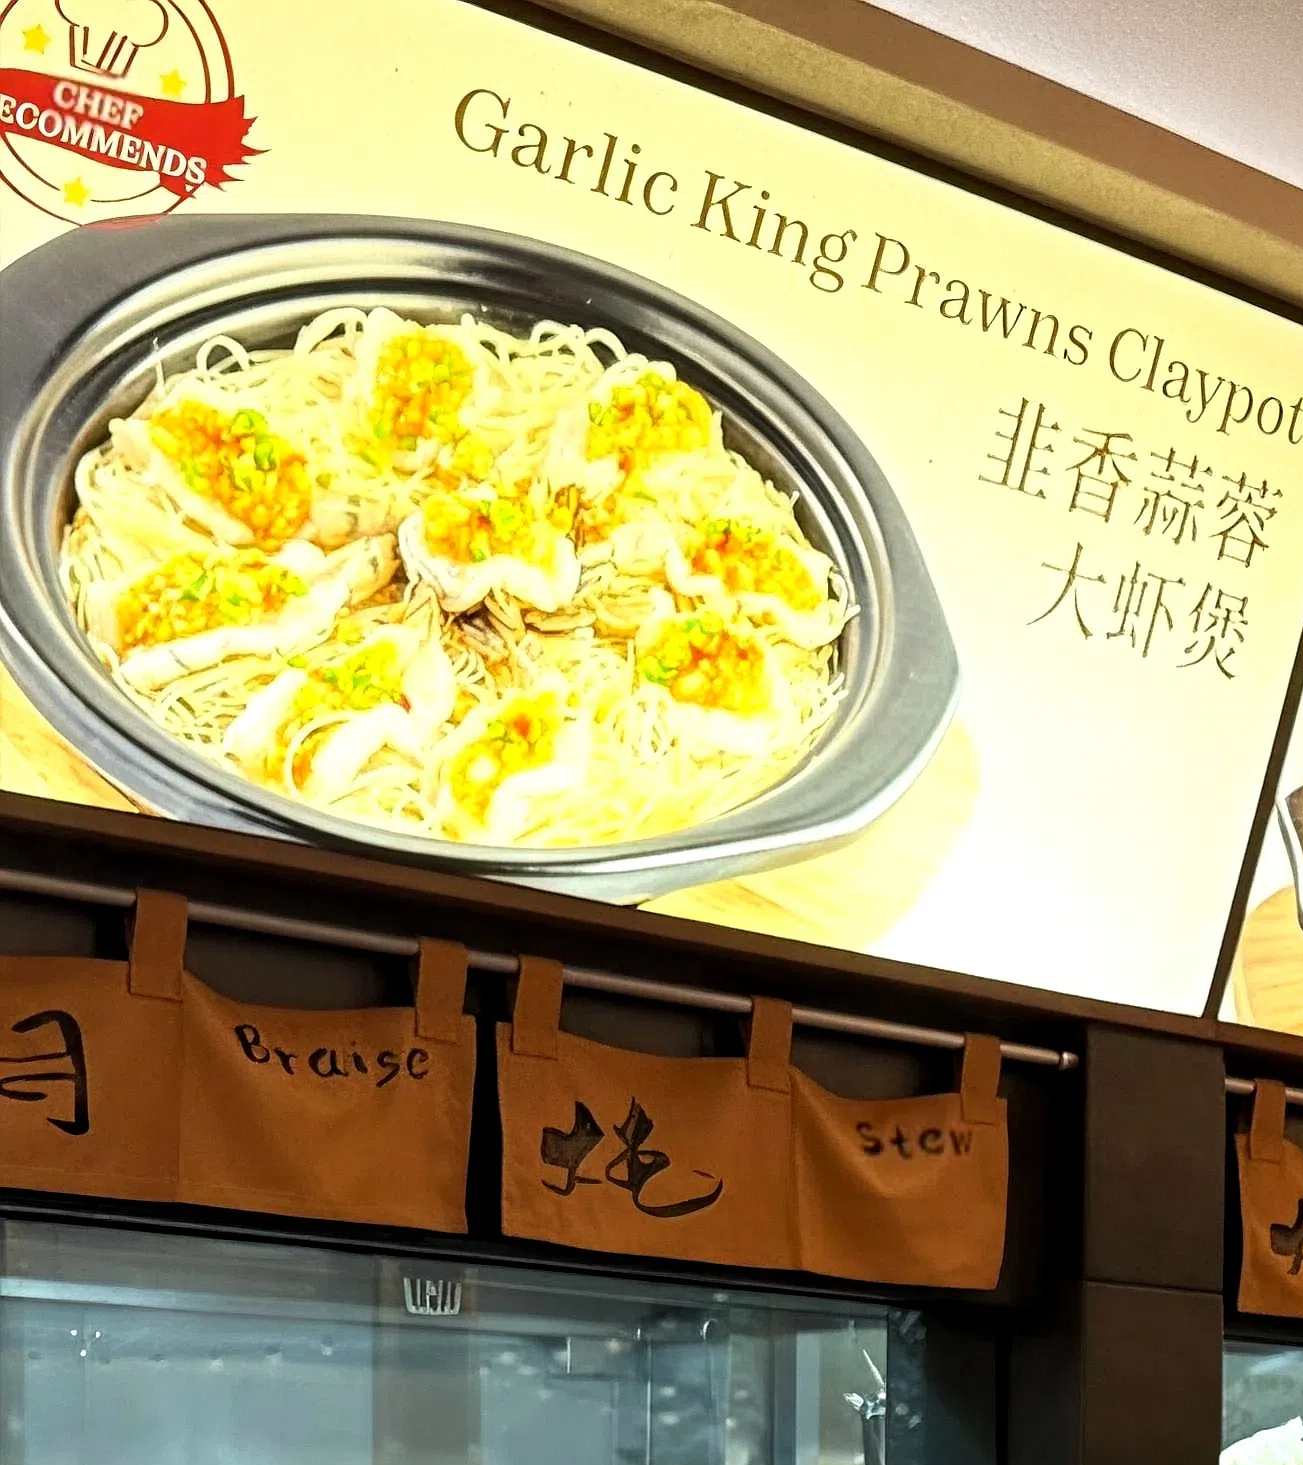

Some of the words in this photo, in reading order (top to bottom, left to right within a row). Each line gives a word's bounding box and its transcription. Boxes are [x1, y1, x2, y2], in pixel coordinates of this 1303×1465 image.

[53, 81, 144, 130] CHEF
[454, 88, 678, 216] Garlic
[690, 169, 857, 293] King
[861, 232, 1093, 366] Prawns
[978, 396, 1283, 569] 韭香蒜蓉
[1026, 542, 1249, 680] 大虾煲
[234, 1023, 429, 1089] Braise
